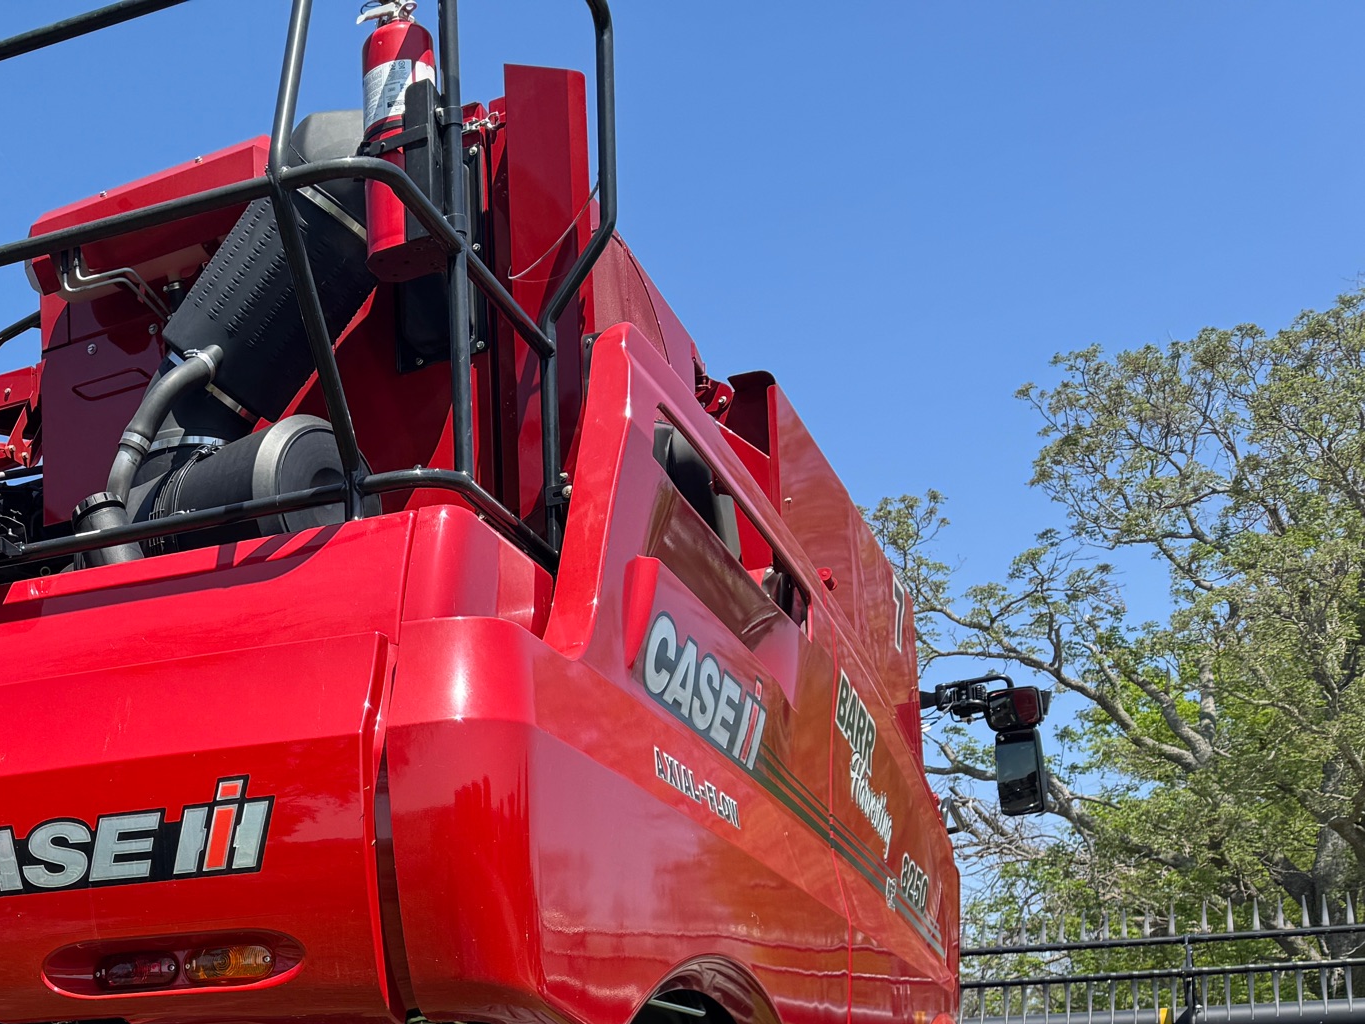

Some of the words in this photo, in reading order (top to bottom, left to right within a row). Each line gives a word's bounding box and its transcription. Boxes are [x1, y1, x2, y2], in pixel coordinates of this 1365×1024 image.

[892, 574, 906, 653] 7
[646, 612, 742, 749] CASE
[835, 667, 877, 778] BARR
[653, 745, 741, 829] AXIAL-FLOW
[849, 750, 893, 862] Harvesting
[901, 851, 929, 915] 8250
